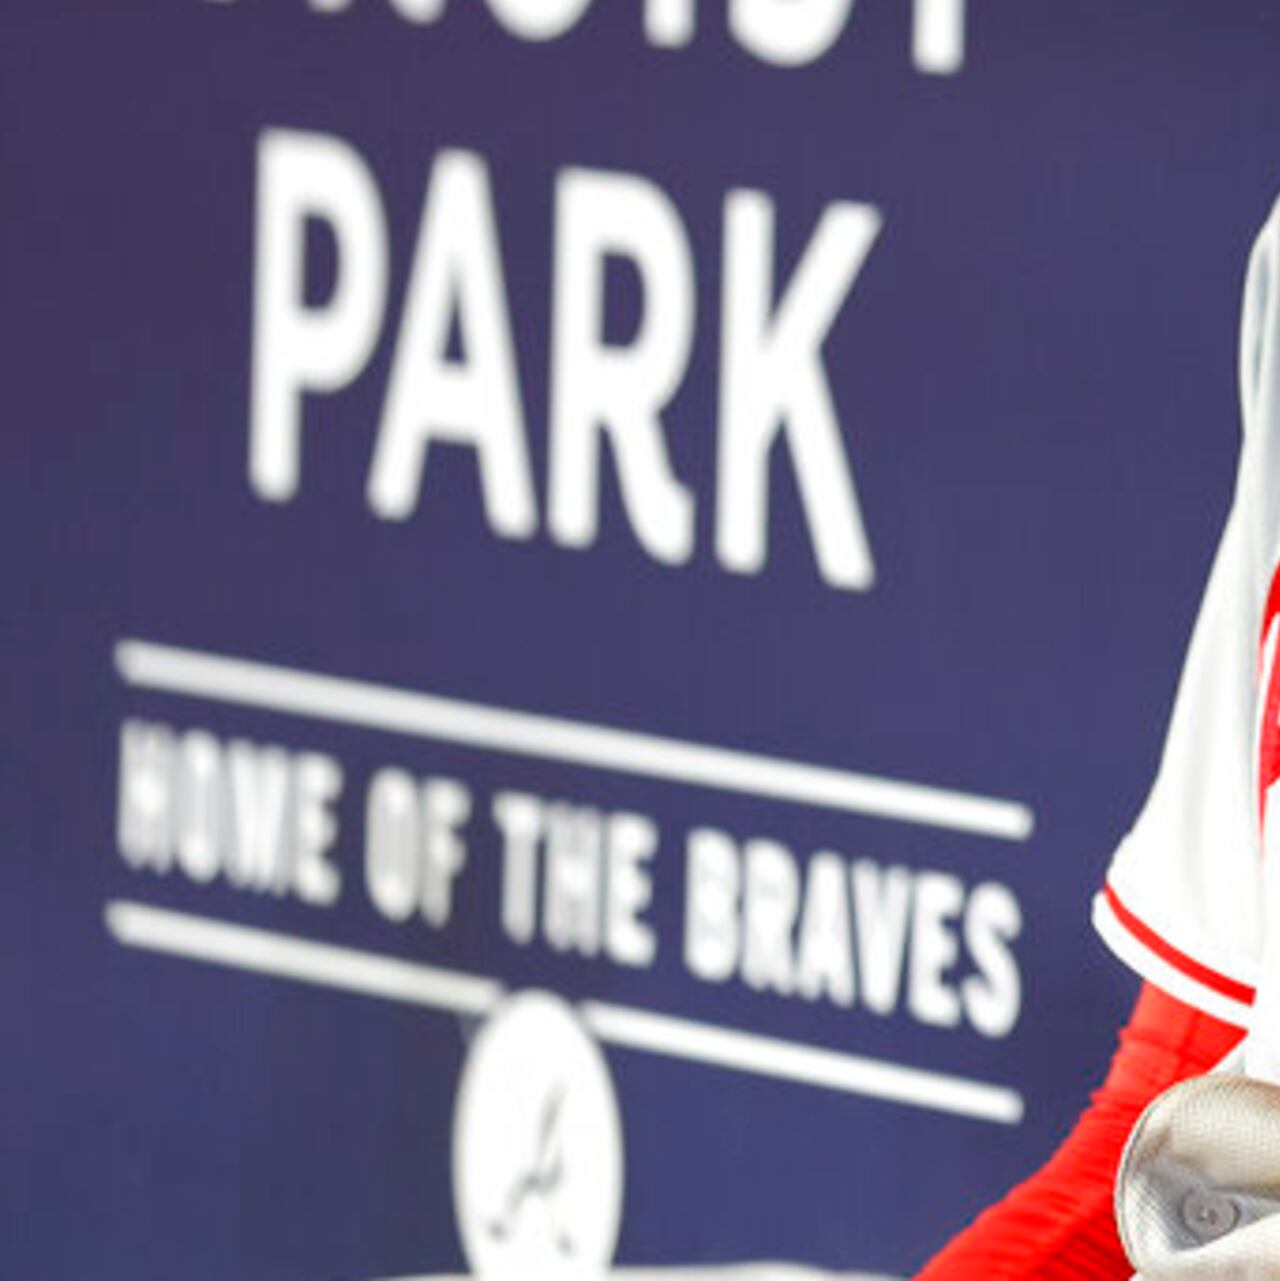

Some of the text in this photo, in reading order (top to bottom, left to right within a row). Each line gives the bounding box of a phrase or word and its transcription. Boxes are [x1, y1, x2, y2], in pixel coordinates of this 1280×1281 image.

[249, 127, 883, 592] PARK
[117, 718, 1022, 1039] HOME OF THE BRAVES
